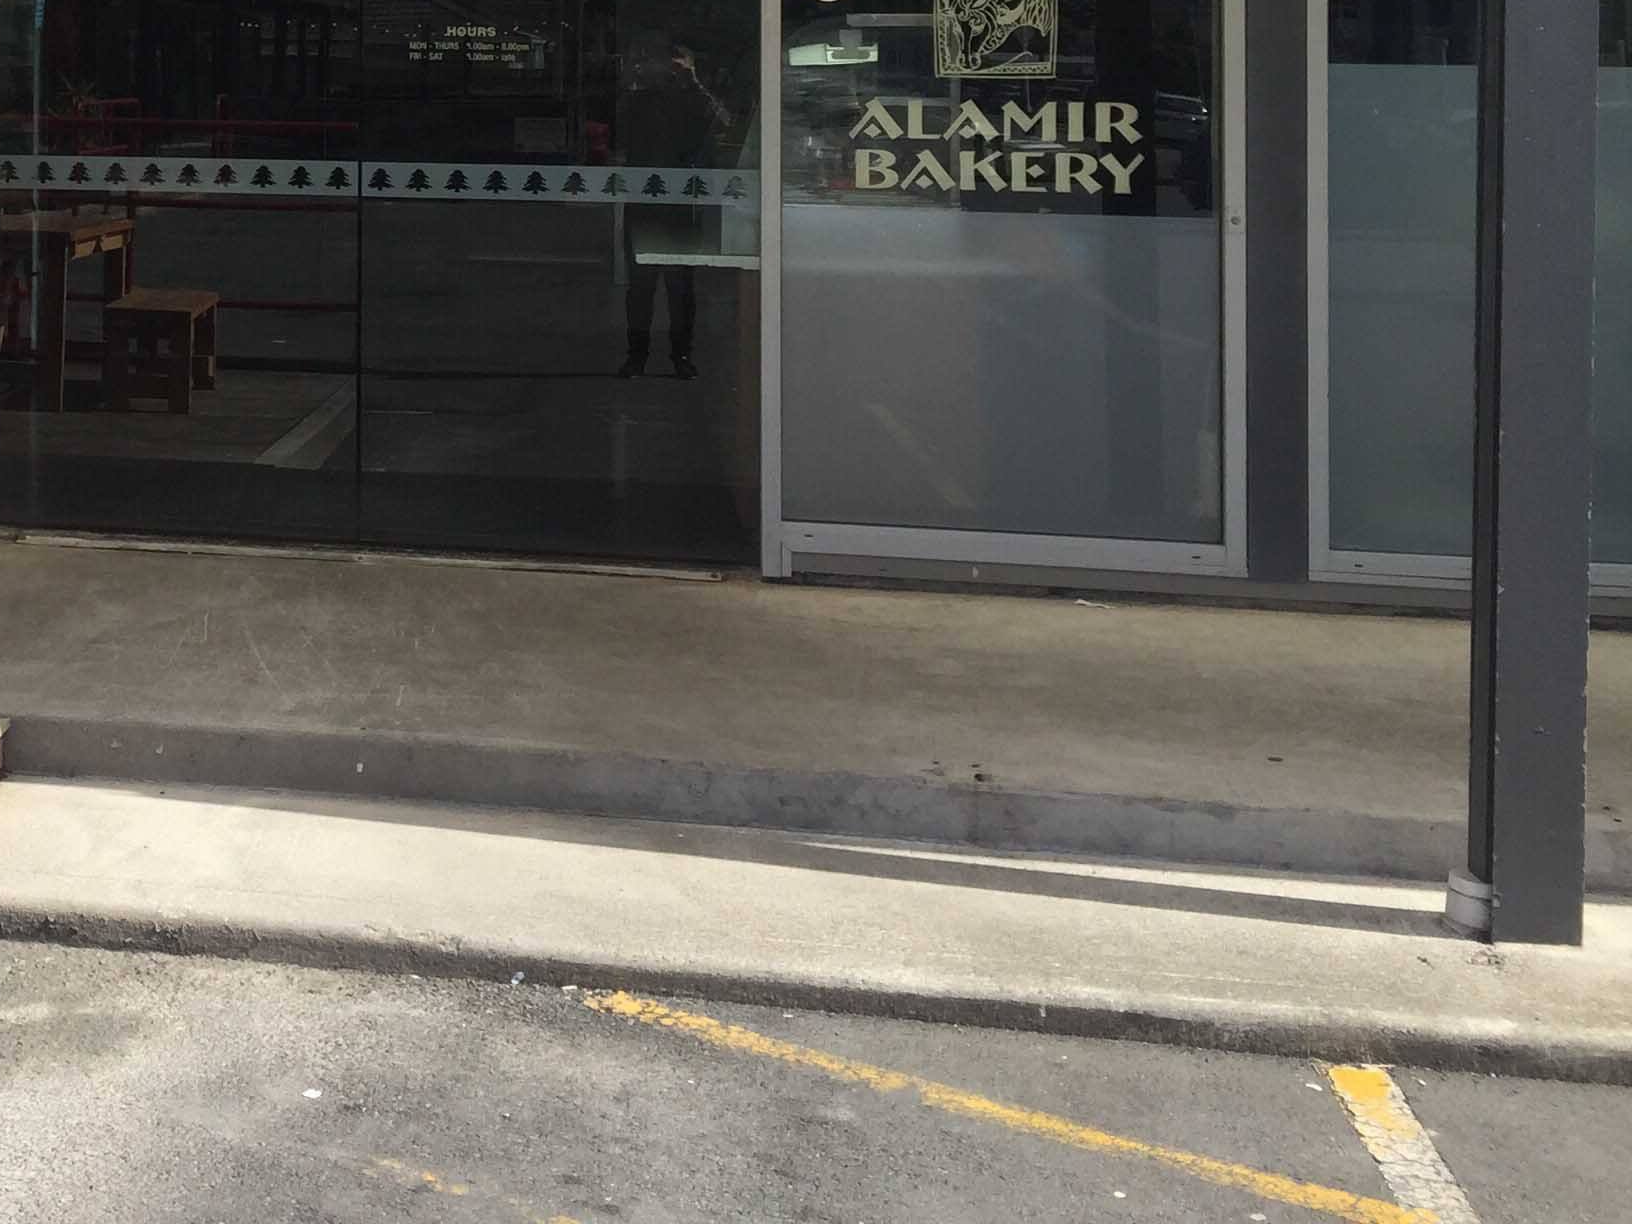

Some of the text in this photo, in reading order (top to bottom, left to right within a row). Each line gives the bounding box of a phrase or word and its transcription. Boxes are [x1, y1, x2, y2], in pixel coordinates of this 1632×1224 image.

[447, 26, 497, 37] HOURS
[848, 97, 1144, 145] ALAMIR
[855, 148, 1145, 195] BAKERY
